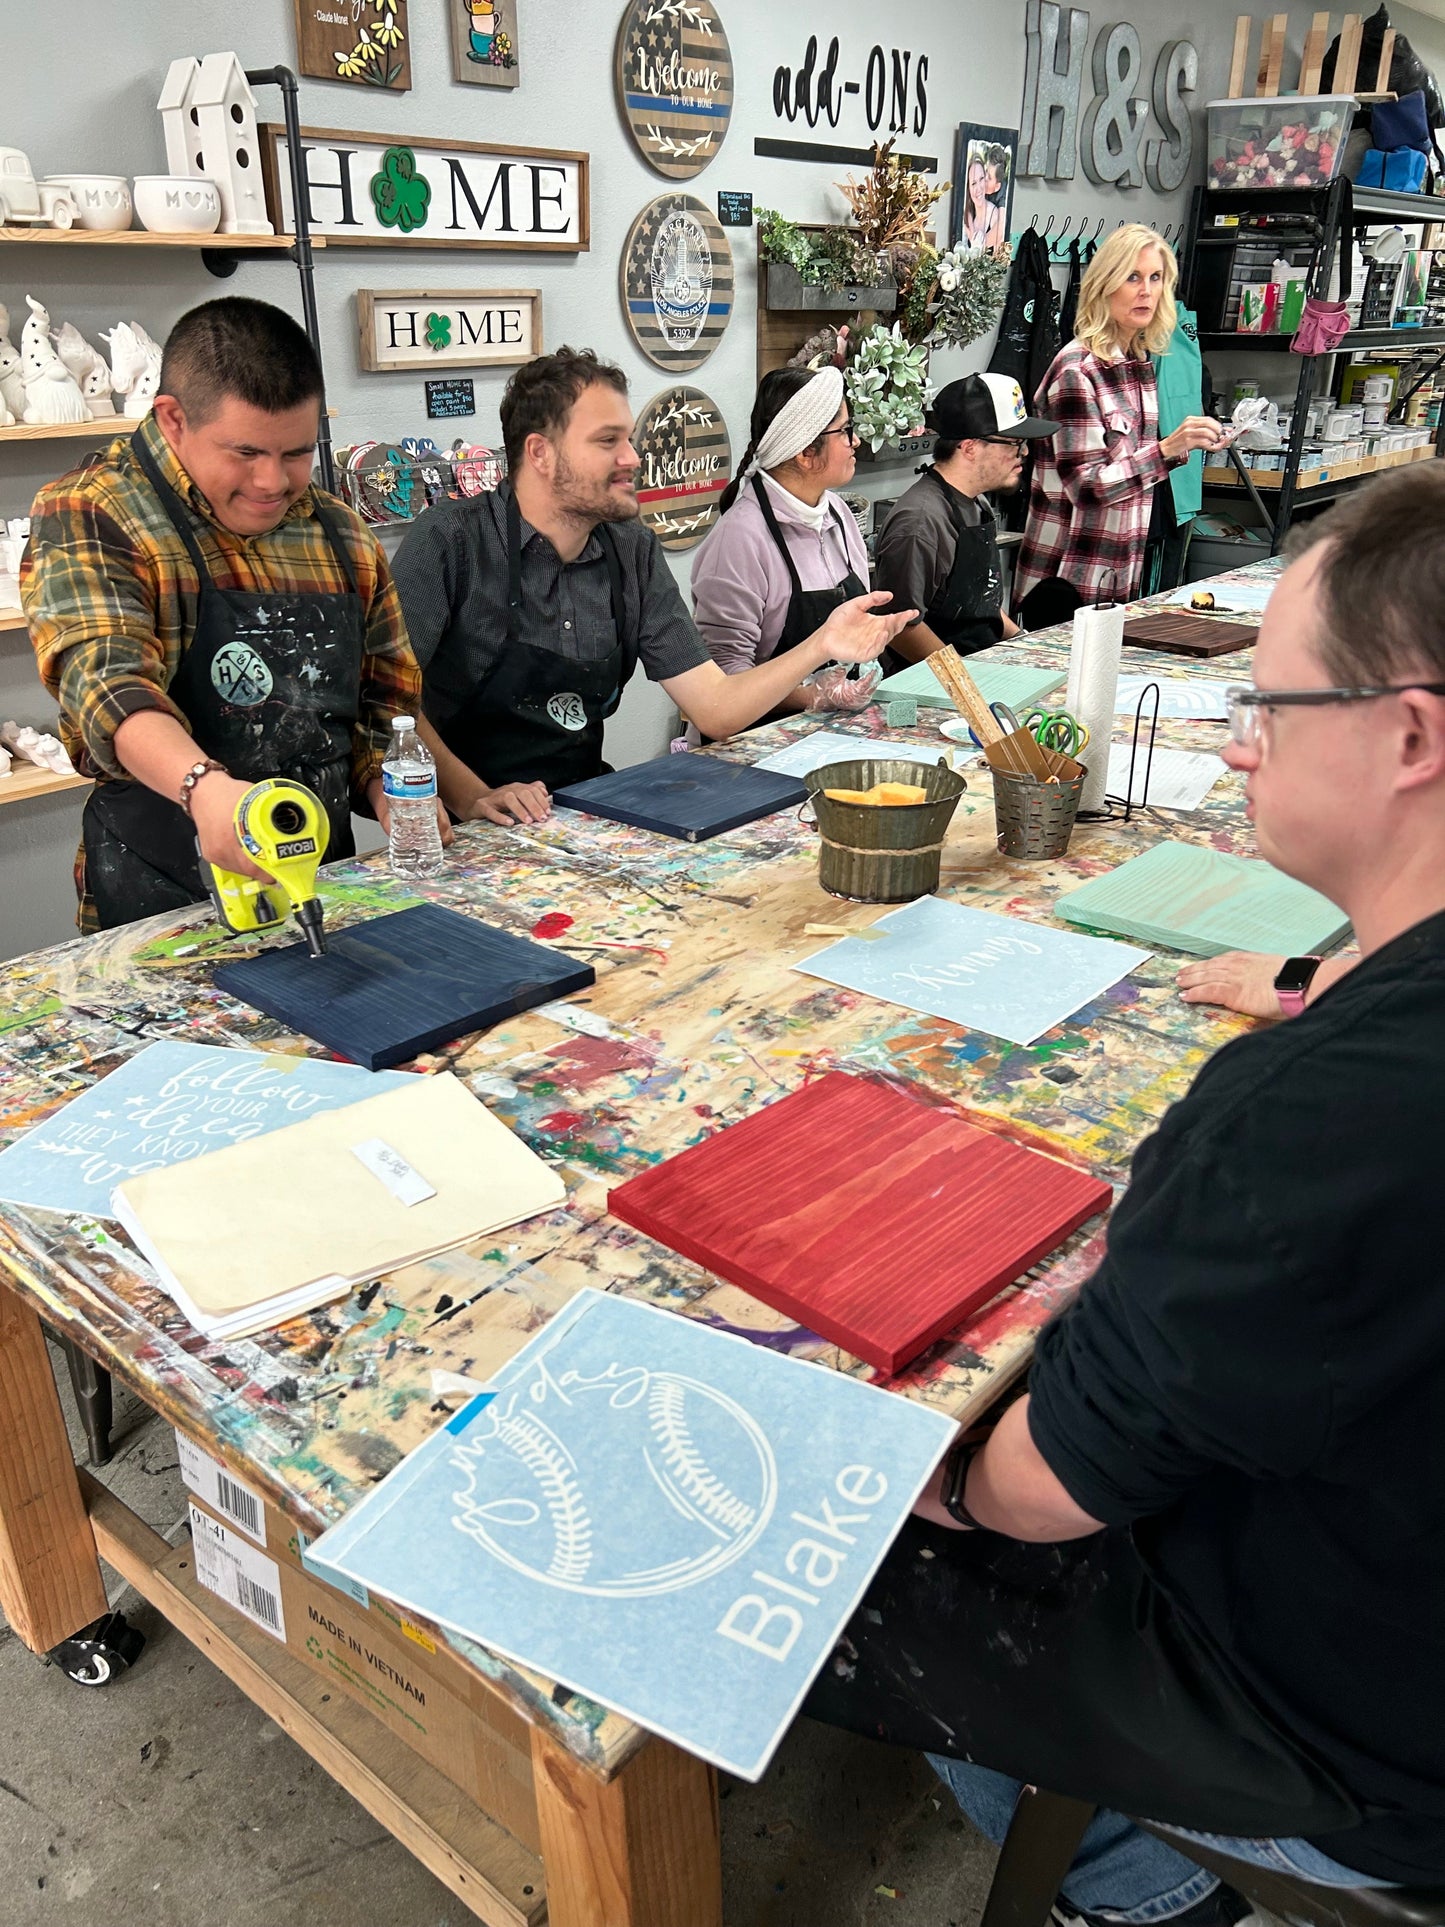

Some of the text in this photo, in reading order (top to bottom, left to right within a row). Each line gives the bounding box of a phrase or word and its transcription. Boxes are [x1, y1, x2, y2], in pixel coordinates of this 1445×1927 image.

[636, 46, 721, 98] Welcome
[772, 34, 929, 138] add-ONS
[670, 93, 713, 109] TO OUR HOME
[1016, 0, 1198, 192] H&S
[659, 218, 705, 251] SERGEANT
[656, 296, 707, 318] LOS ANGELES POLICE
[672, 328, 691, 339] 5392
[645, 446, 720, 489] Welcome
[675, 478, 713, 493] TO OUR HOME
[277, 839, 315, 858] RYOBI
[891, 934, 1043, 992] Kimmy
[159, 1056, 334, 1112] follow
[192, 1095, 269, 1119] YOUR
[58, 1121, 129, 1147] THEY
[529, 1356, 650, 1409] day
[191, 1507, 227, 1543] OT-41
[716, 1463, 888, 1663] Blake
[308, 1605, 347, 1645] MADE
[348, 1635, 363, 1656] IN
[364, 1648, 427, 1707] VIETNAM
